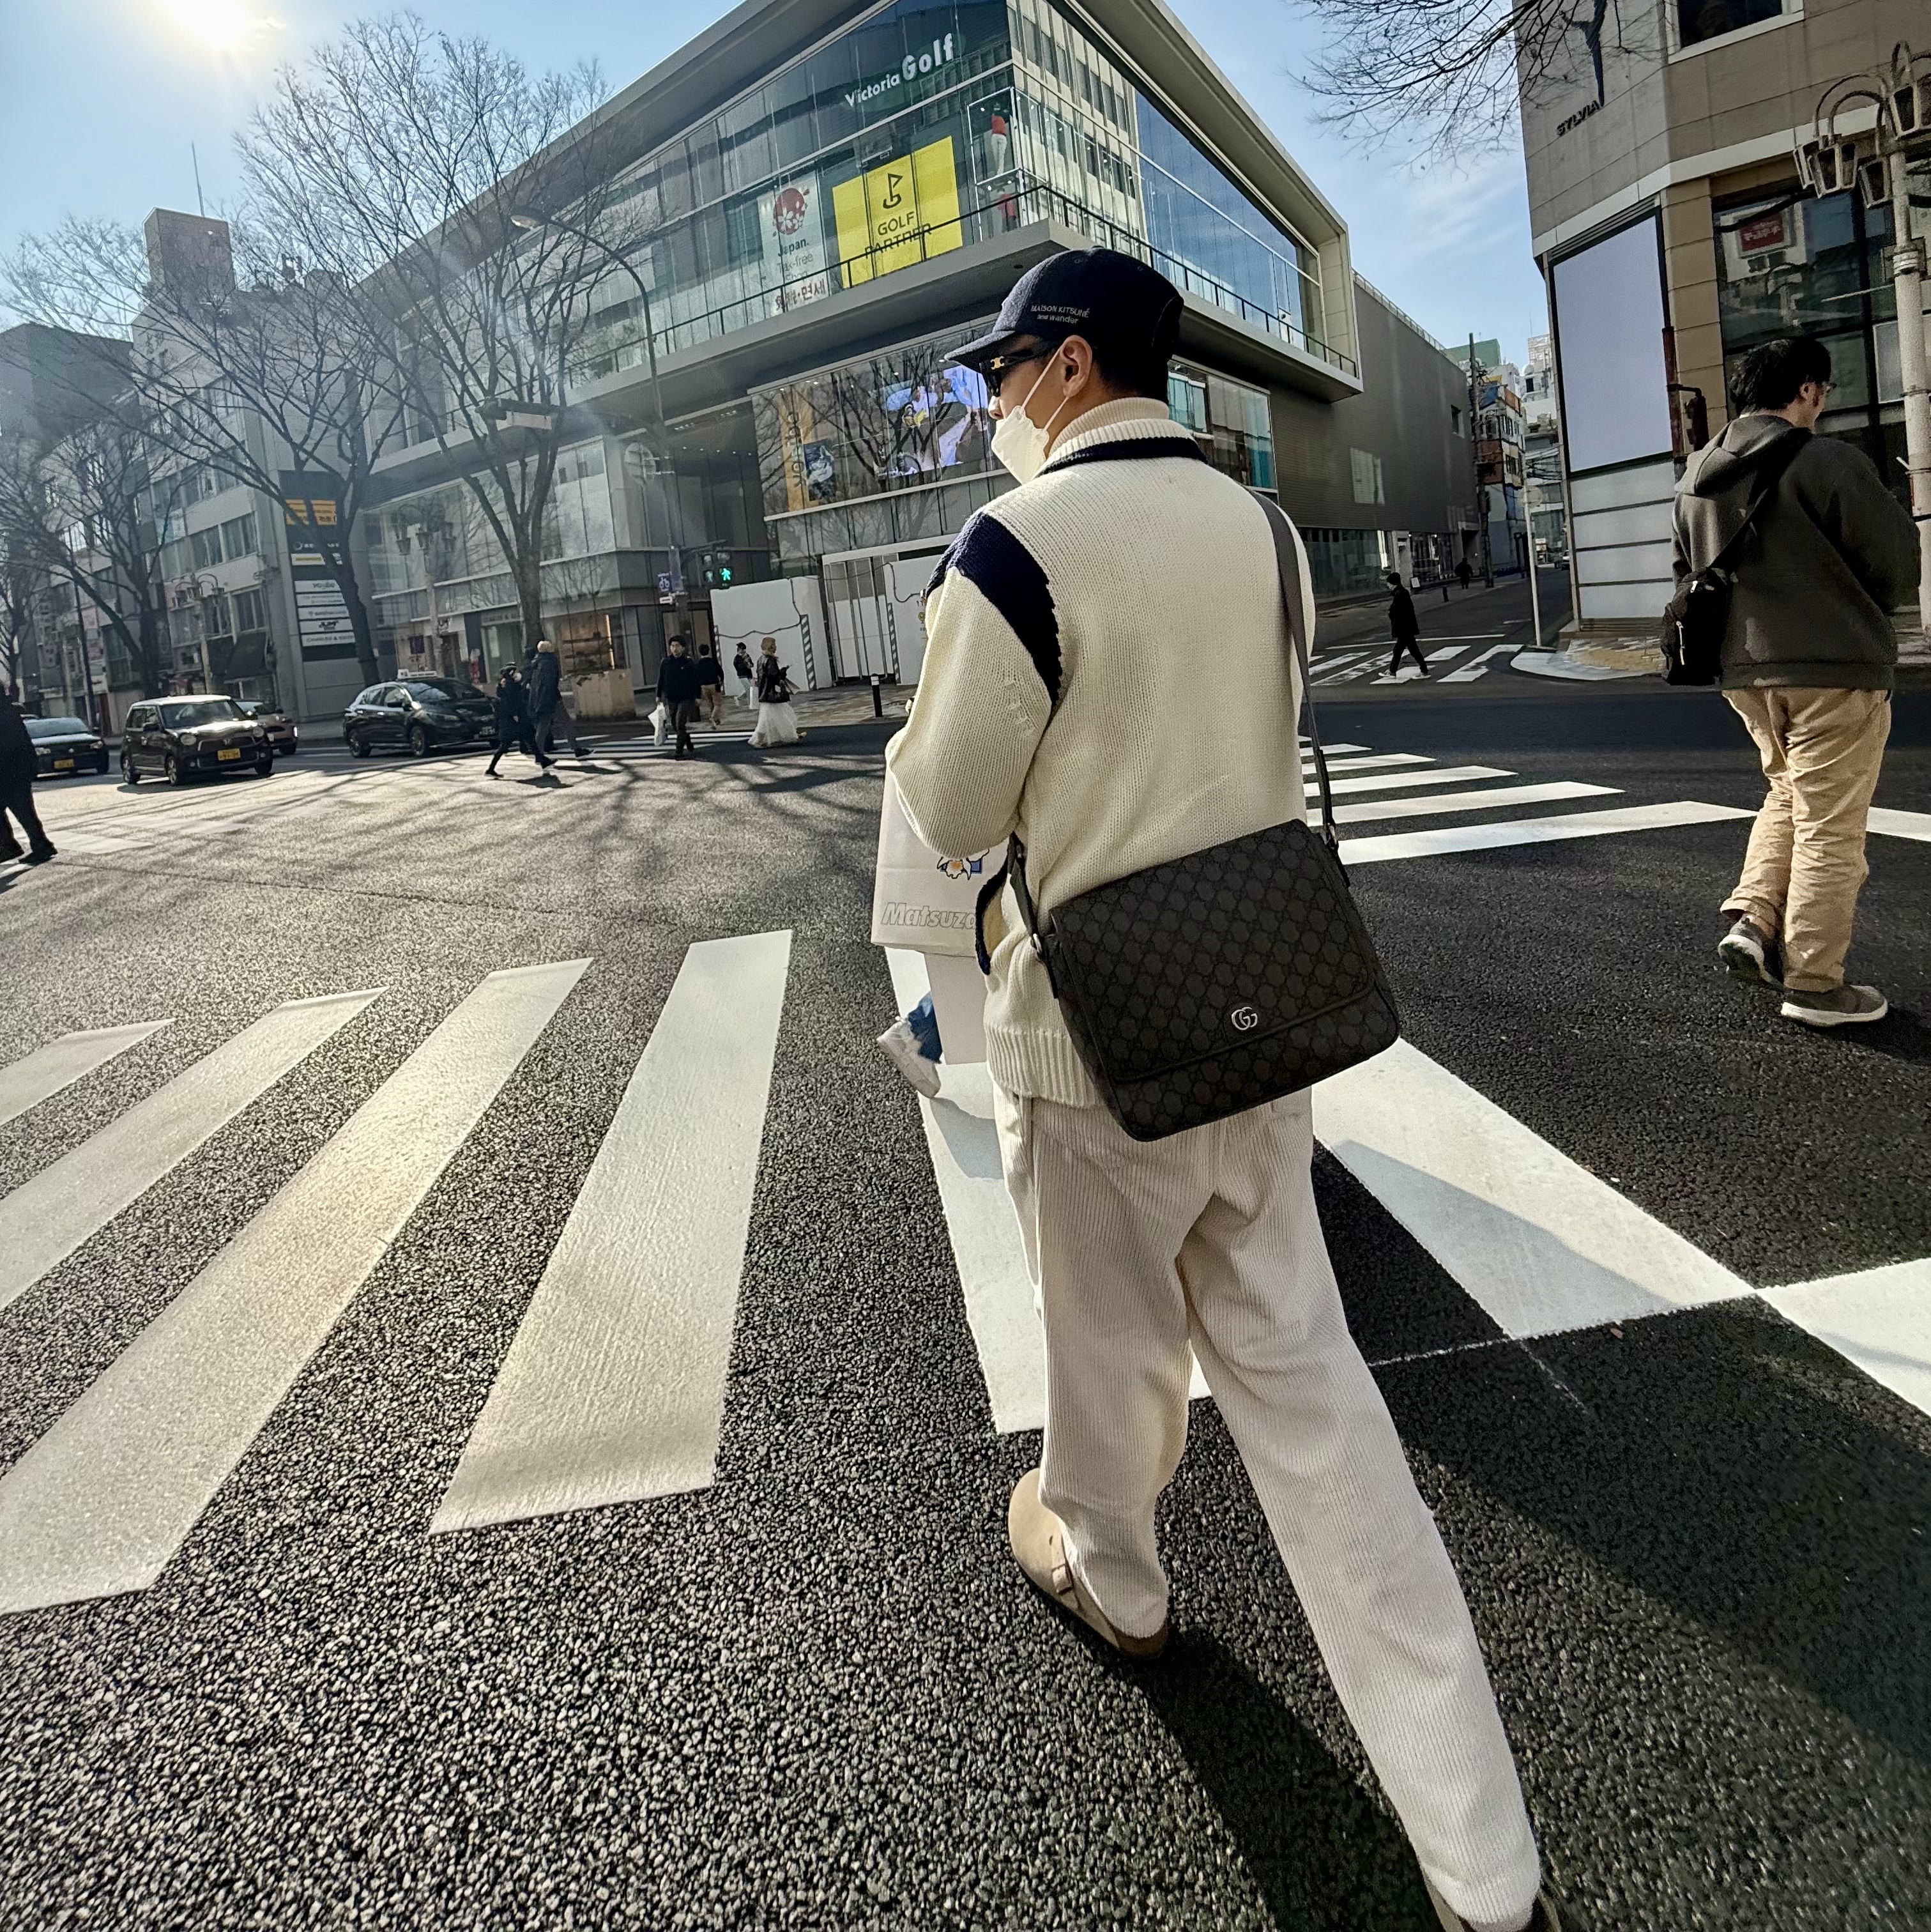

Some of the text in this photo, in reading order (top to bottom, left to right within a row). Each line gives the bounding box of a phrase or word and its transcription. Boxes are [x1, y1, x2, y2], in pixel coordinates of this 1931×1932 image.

[844, 33, 954, 107] Victoria Golf
[1556, 100, 1600, 136] SYLVIA
[878, 211, 914, 235] GOLF
[1049, 315, 1080, 324] wander
